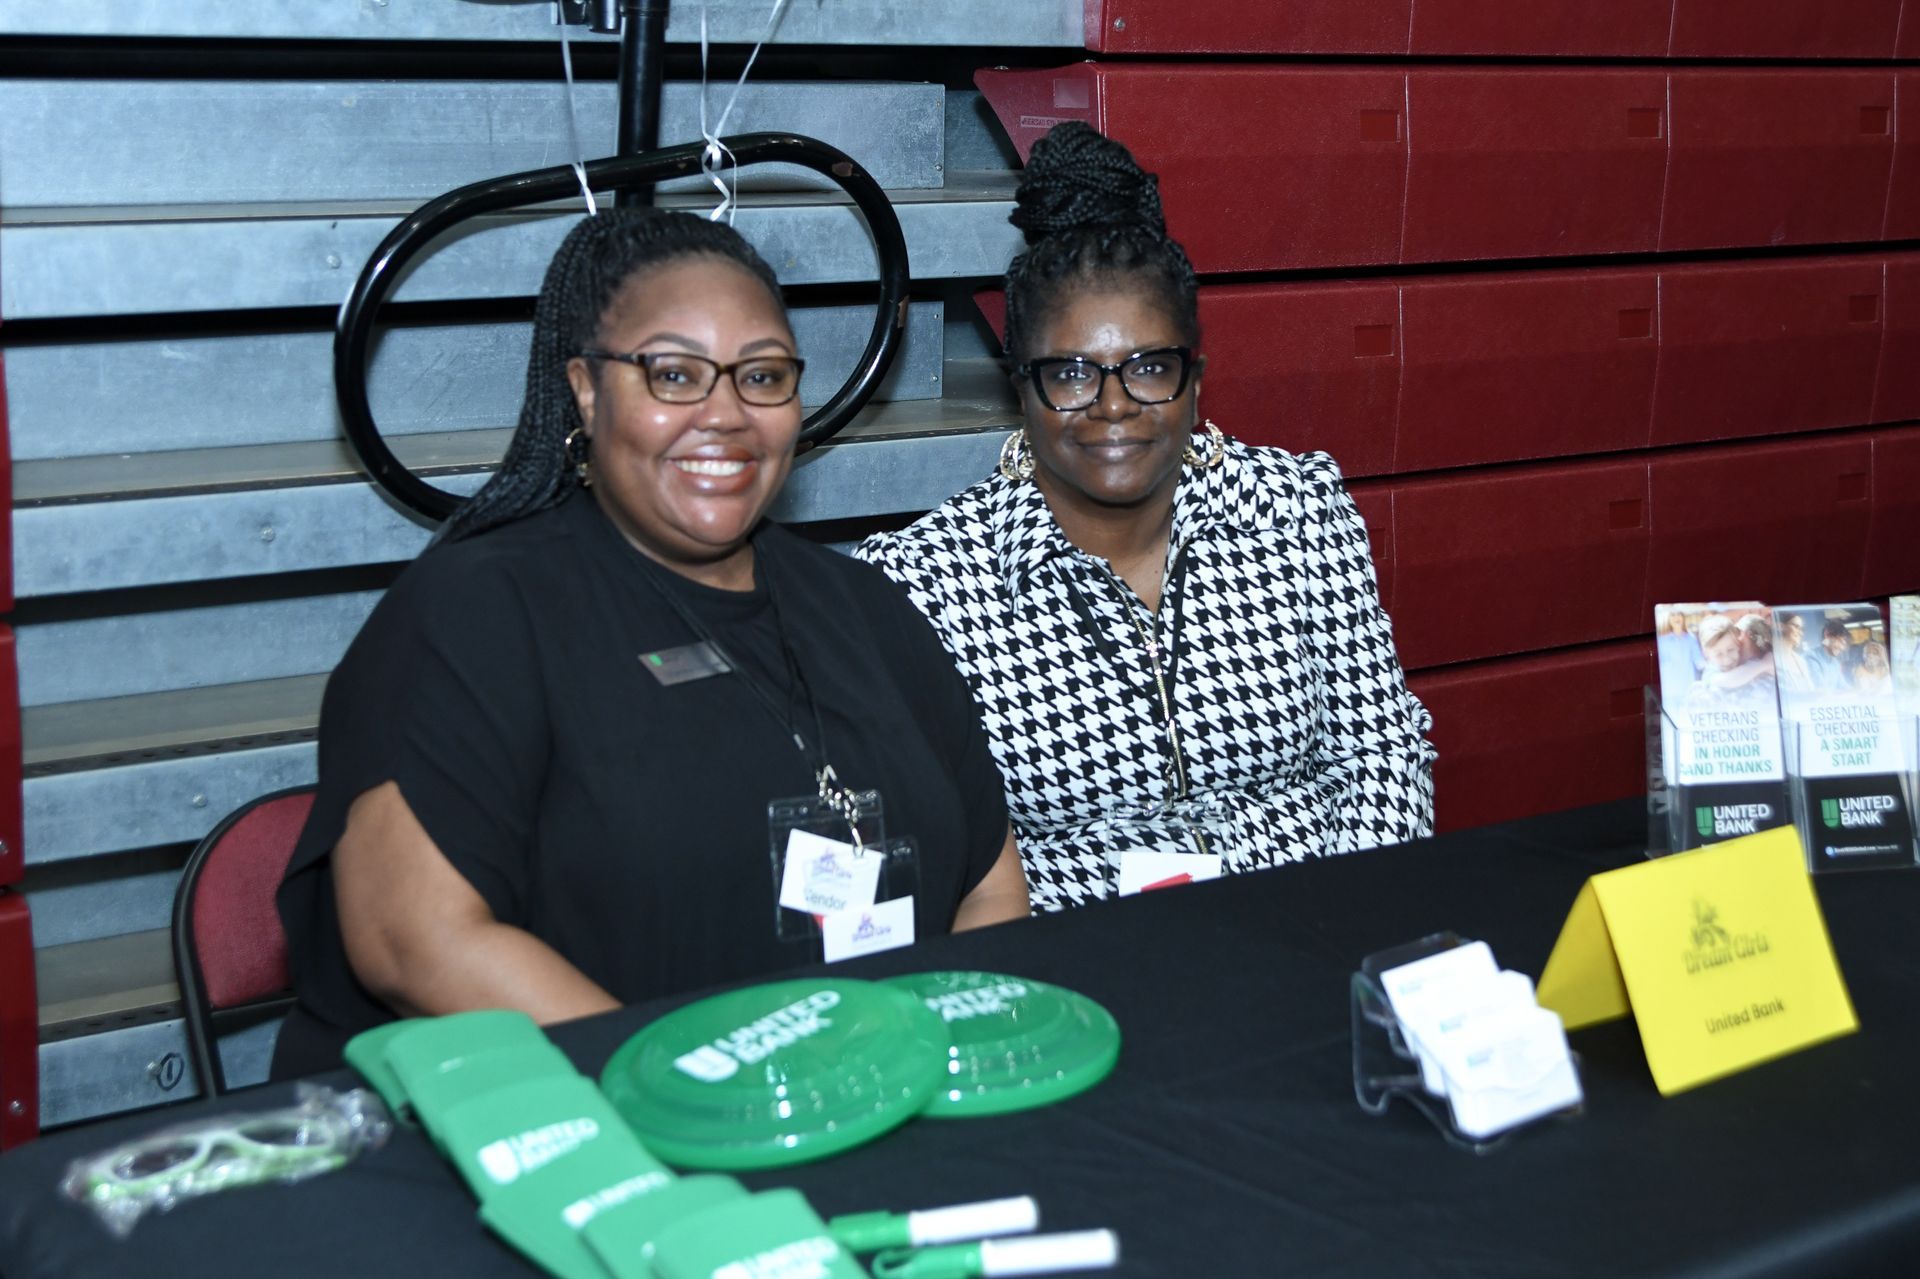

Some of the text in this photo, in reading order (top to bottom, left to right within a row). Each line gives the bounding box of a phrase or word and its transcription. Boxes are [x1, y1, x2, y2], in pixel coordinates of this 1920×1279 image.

[1689, 709, 1760, 727] VETERANS
[1809, 704, 1880, 722] ESSENTIAL
[1691, 727, 1760, 744] CHECKING
[1814, 720, 1880, 737] CHECKING
[1694, 744, 1761, 760] IN HONOR
[1820, 735, 1879, 752] A SMART
[1717, 759, 1773, 775] THANKS
[1831, 752, 1872, 768] START
[1713, 803, 1771, 820] UNITED
[1839, 795, 1895, 812] UNITED
[1714, 818, 1756, 835] BANK
[1840, 810, 1881, 826] BANK
[714, 989, 842, 1053] UNITED
[1704, 996, 1784, 1034] United Bank
